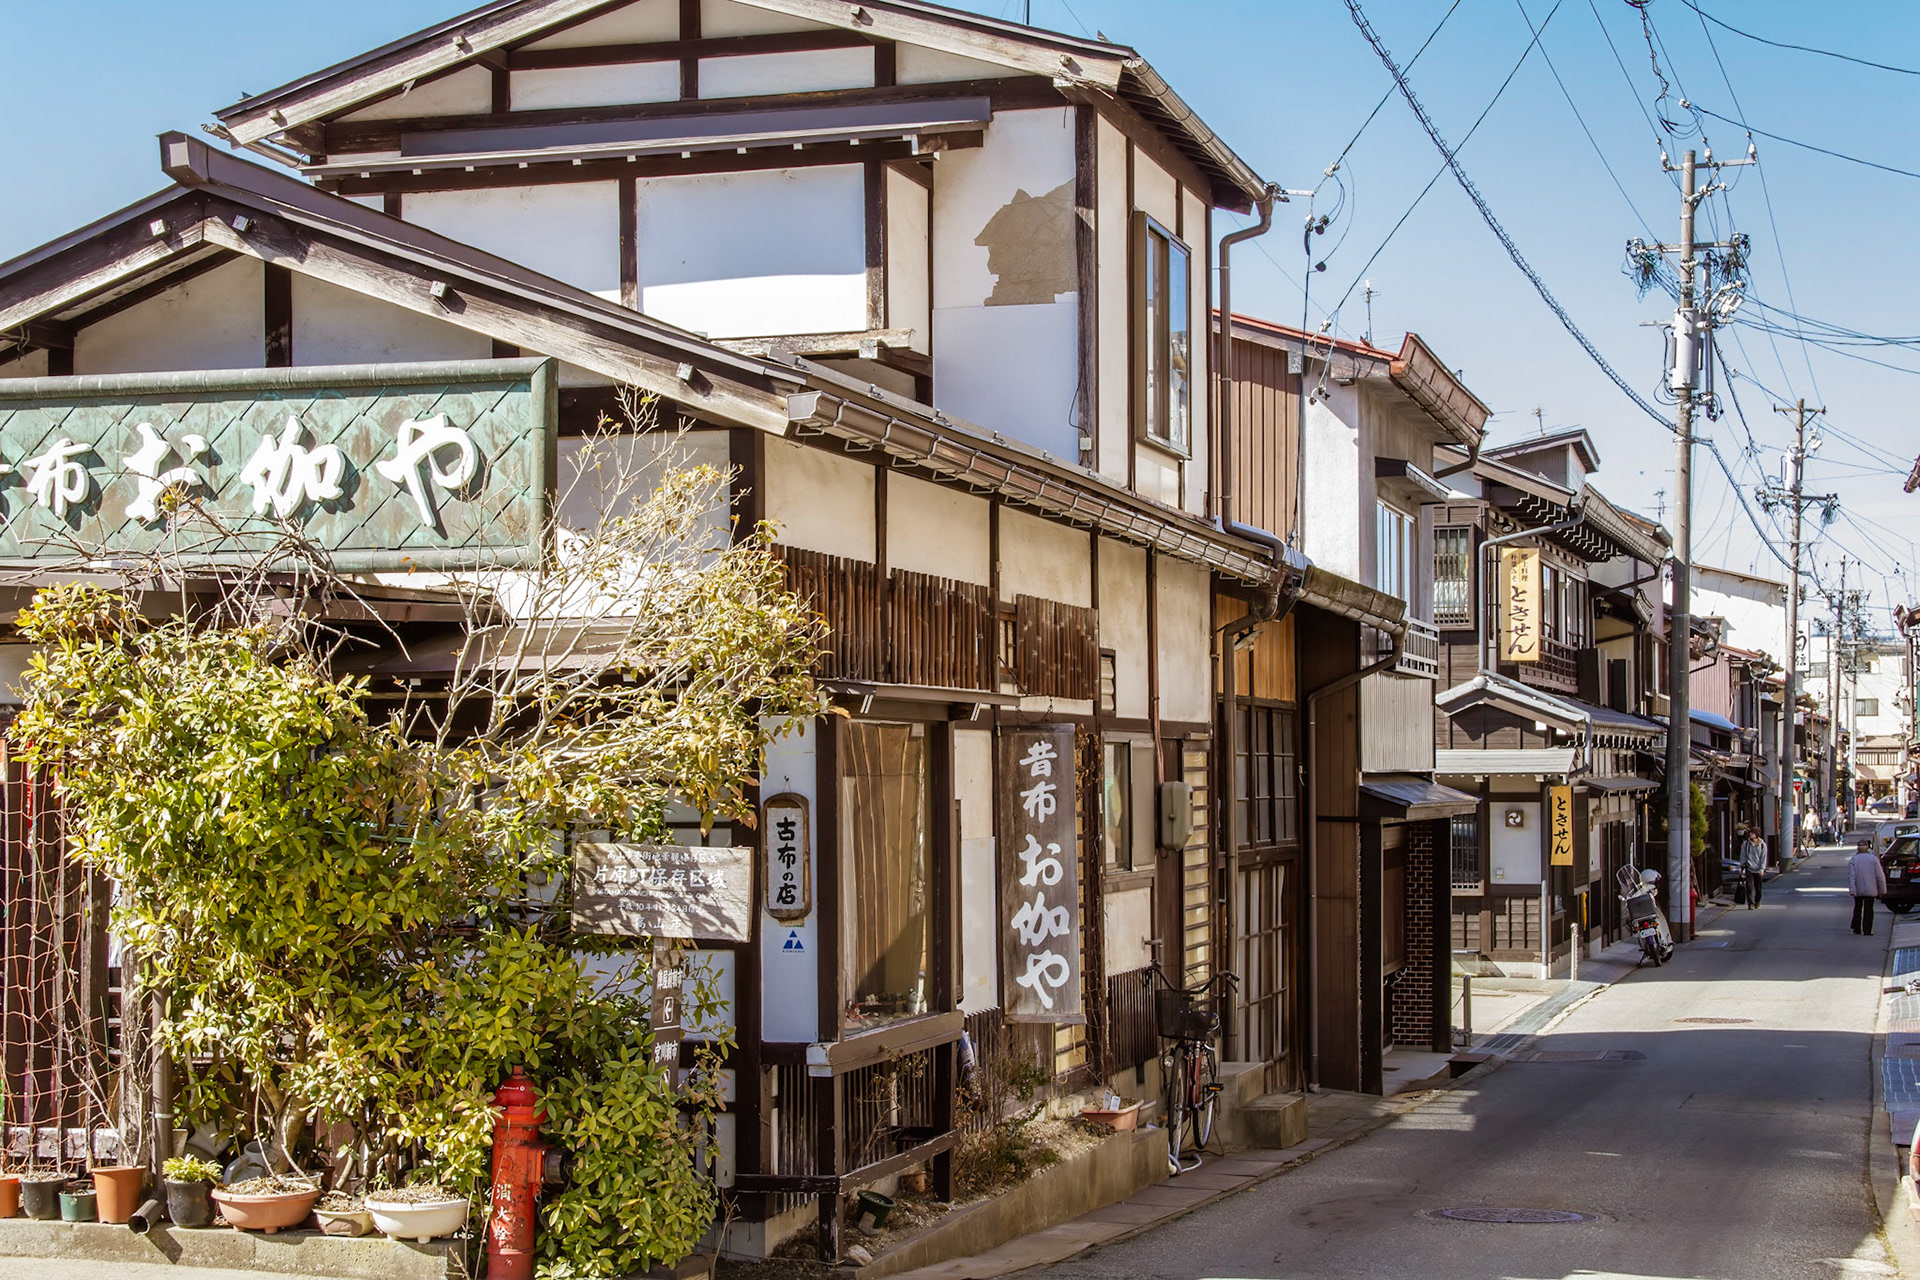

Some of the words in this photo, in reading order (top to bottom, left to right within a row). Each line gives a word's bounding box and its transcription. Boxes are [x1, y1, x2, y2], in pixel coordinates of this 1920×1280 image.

[0, 412, 479, 527] 布お伽や
[1506, 586, 1536, 655] ときせん
[1554, 796, 1571, 855] ときせん
[593, 865, 727, 888] 片原町保存区域
[776, 816, 797, 905] 古布の店
[1010, 740, 1071, 1010] 昔布お伽や
[634, 917, 682, 930] 高山市
